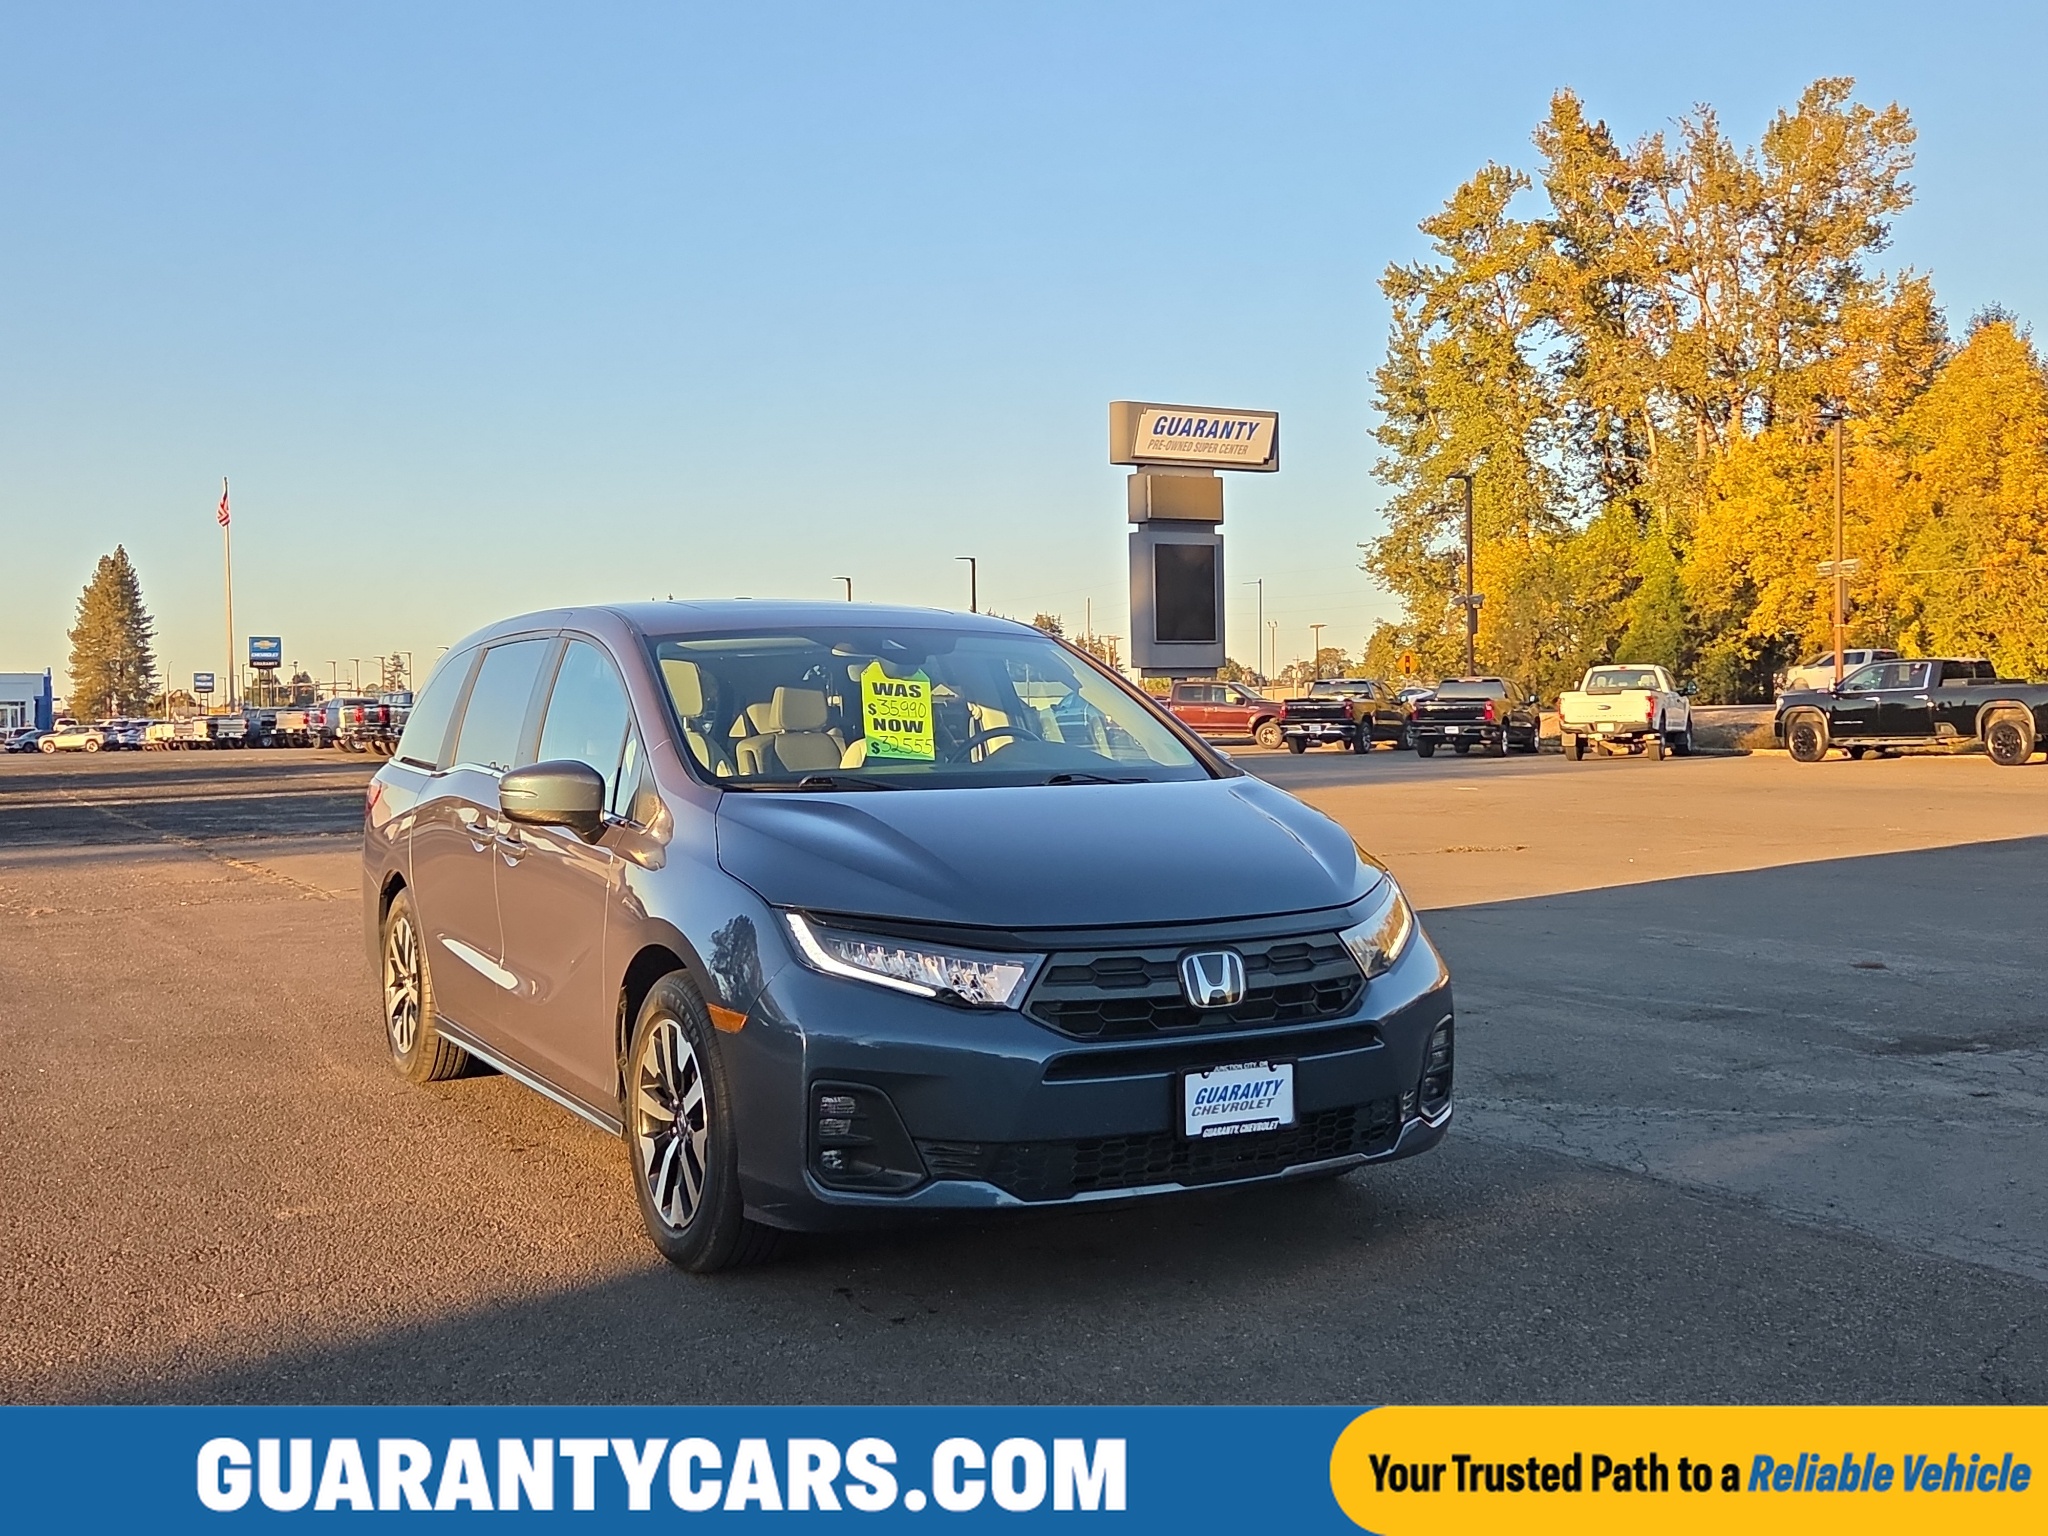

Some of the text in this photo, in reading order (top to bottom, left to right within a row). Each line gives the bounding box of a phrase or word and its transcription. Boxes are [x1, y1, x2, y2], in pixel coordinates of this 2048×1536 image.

[1152, 415, 1260, 441] GUARANTY
[1147, 438, 1249, 455] PRE-OWNED SUPER CENTER
[871, 681, 922, 698] WAS
[873, 717, 924, 734] NOW
[1194, 1078, 1285, 1105] GUARANTY
[1191, 1097, 1275, 1117] CHEVROLET
[1239, 1119, 1280, 1134] CHEVROLET
